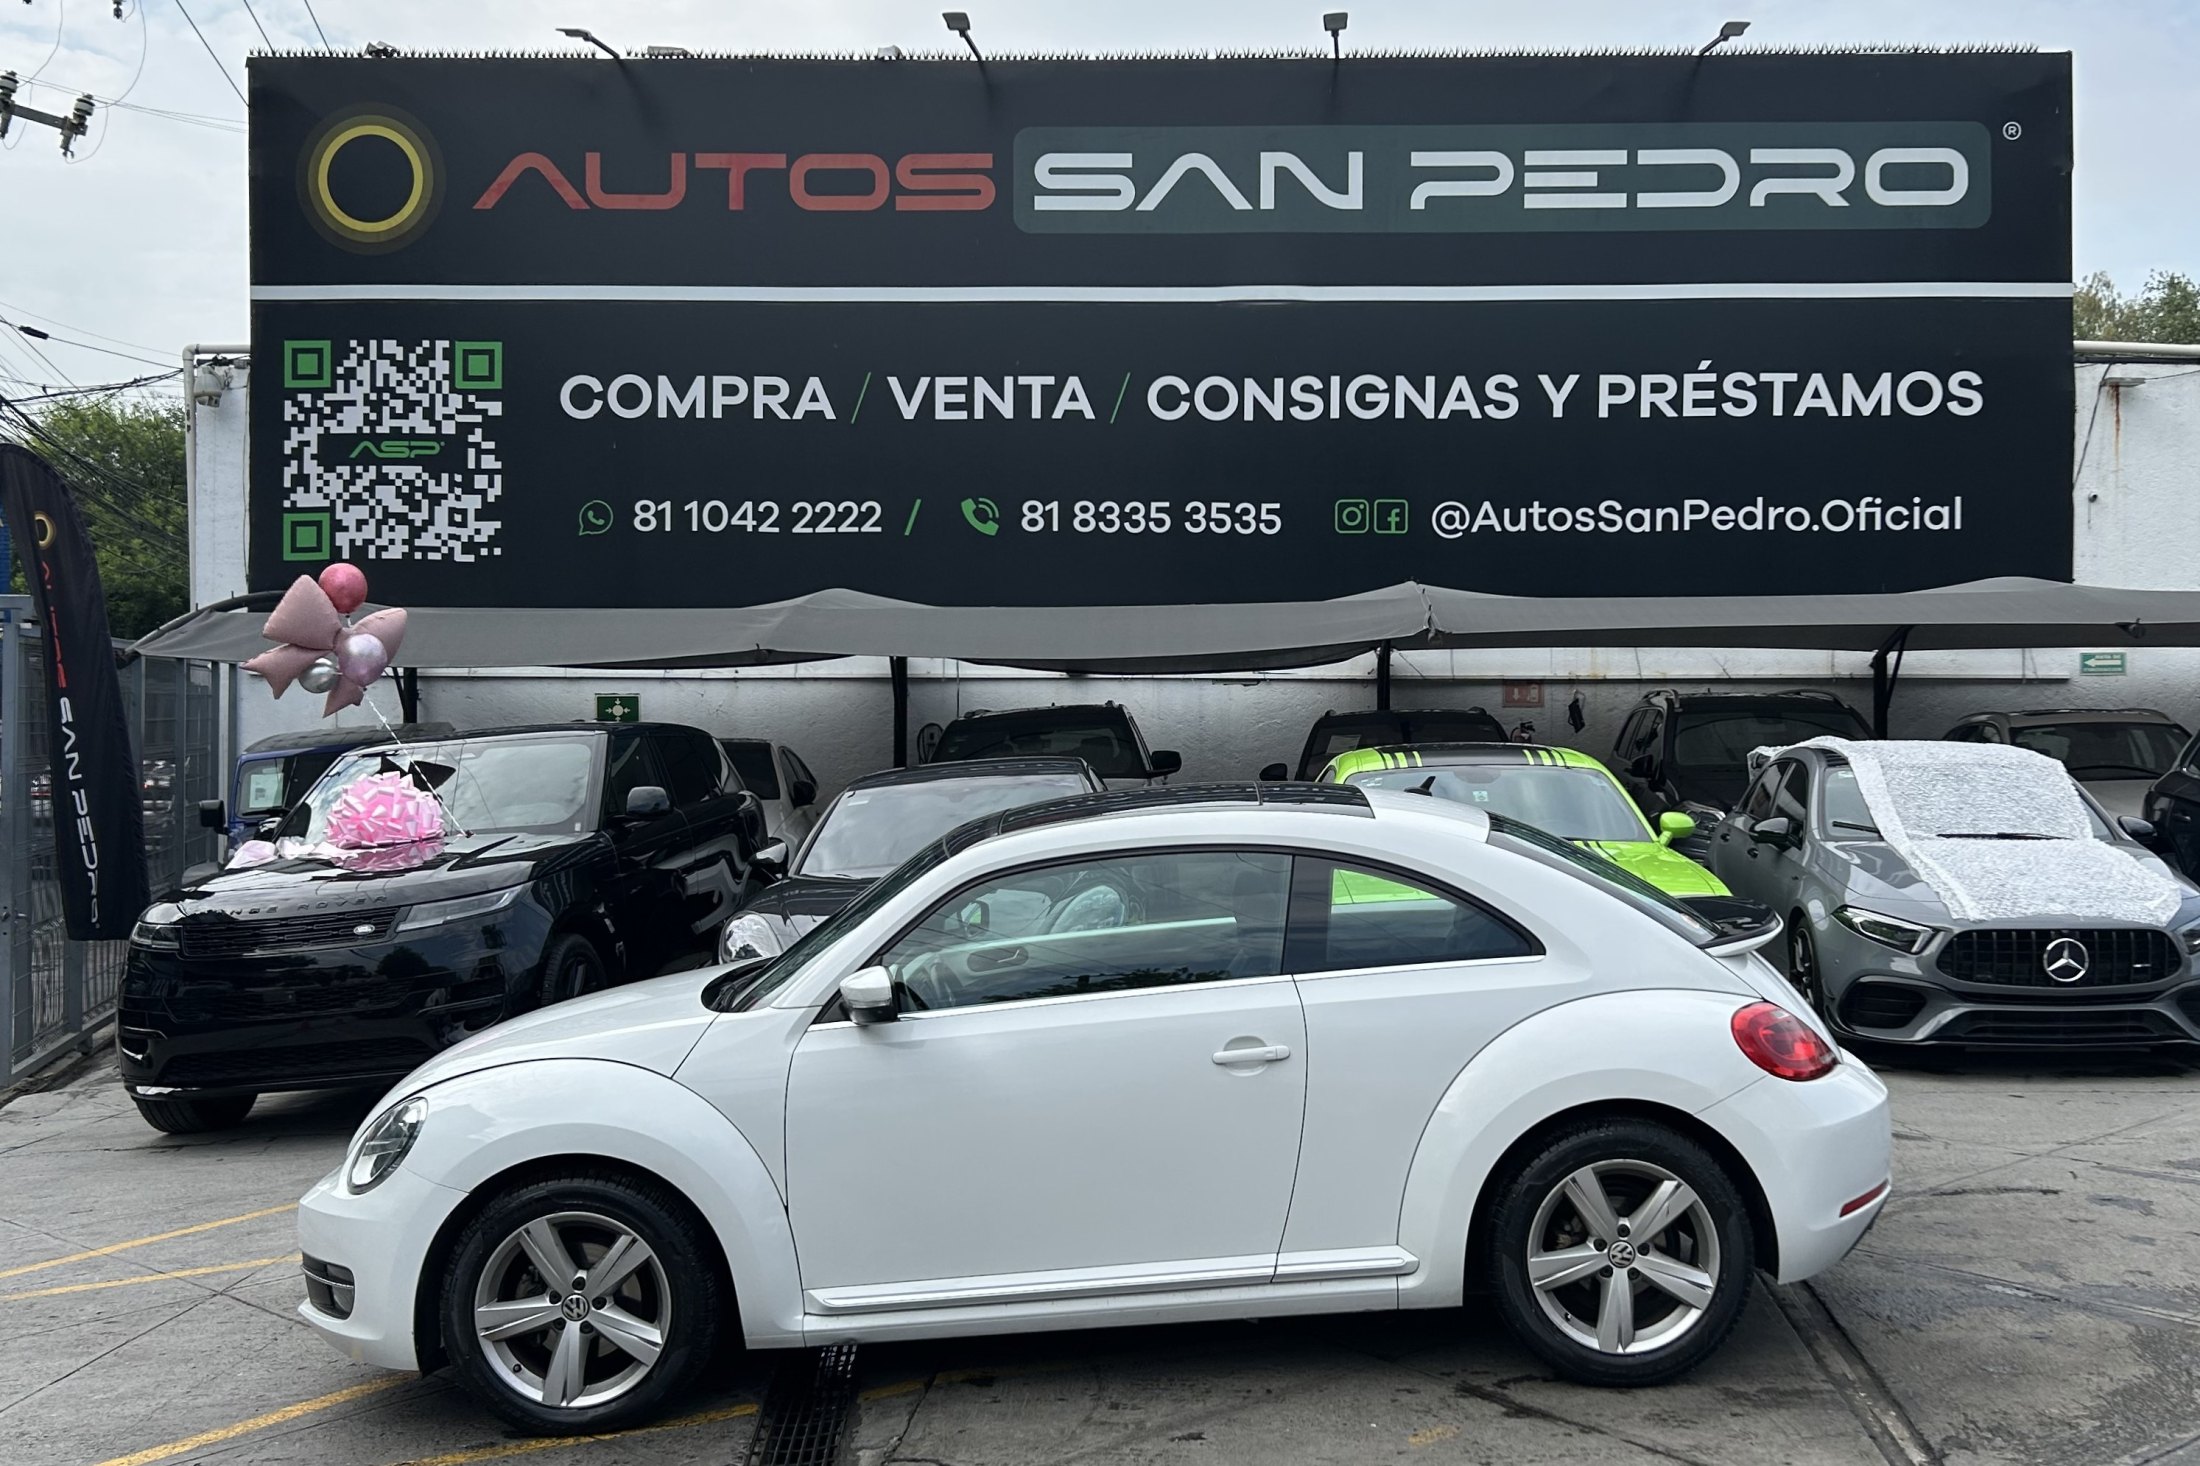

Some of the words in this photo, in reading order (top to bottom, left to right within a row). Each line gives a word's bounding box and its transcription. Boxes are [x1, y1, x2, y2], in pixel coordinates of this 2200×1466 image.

[473, 151, 996, 212] AUTOS
[1034, 151, 1363, 211] SAN
[1410, 147, 1969, 210] PEDRO
[559, 373, 837, 422] COMPRA
[886, 375, 1096, 421] VENTA
[1147, 373, 1520, 422] CONSIGNAS
[1537, 374, 1581, 419] Y
[1599, 359, 1984, 419] PRÉSTAMOS
[349, 440, 441, 459] ASP
[633, 499, 672, 533] 81
[684, 499, 780, 534] 1042
[791, 500, 882, 535] 2222
[1021, 499, 1059, 533] 81
[1072, 500, 1172, 535] 8335
[1184, 500, 1282, 536] 3535
[1431, 495, 1963, 540] @AutosSanPedro.Oficial
[59, 697, 83, 781] SAN
